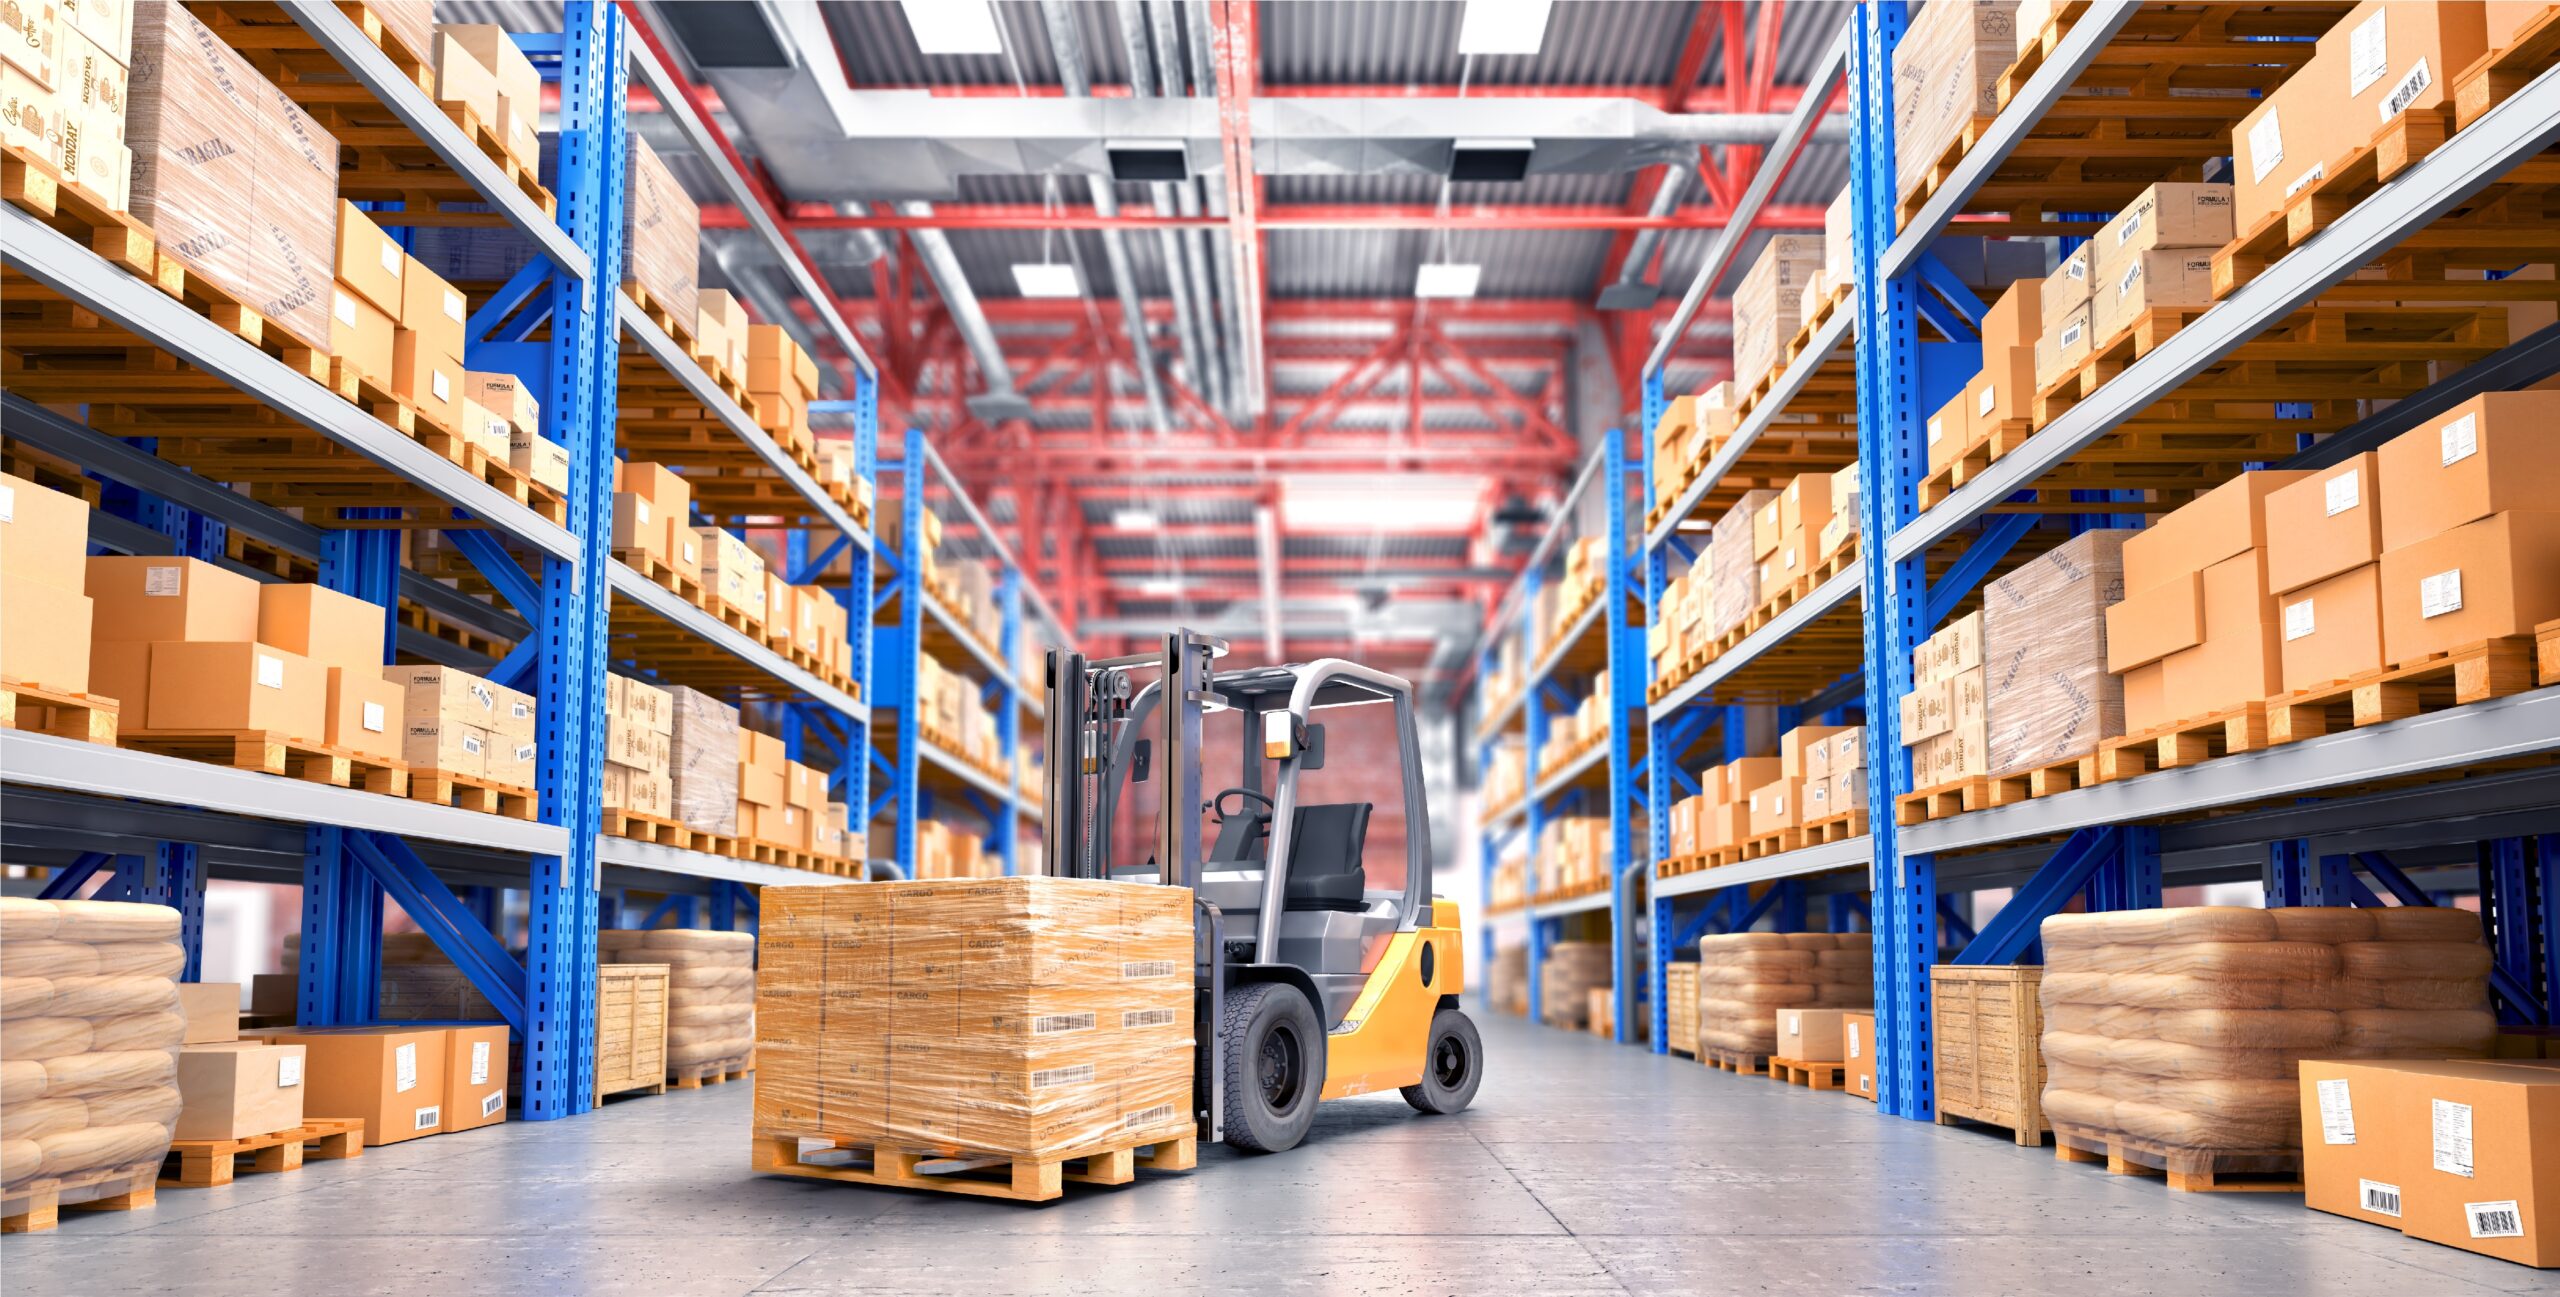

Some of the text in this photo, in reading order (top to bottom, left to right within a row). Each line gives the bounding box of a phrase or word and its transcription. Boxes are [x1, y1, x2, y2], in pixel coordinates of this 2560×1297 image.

[64, 121, 77, 176] MONDAY
[900, 889, 933, 897] CARGO
[968, 940, 1004, 948] CARGO
[897, 992, 928, 1000] CARGO
